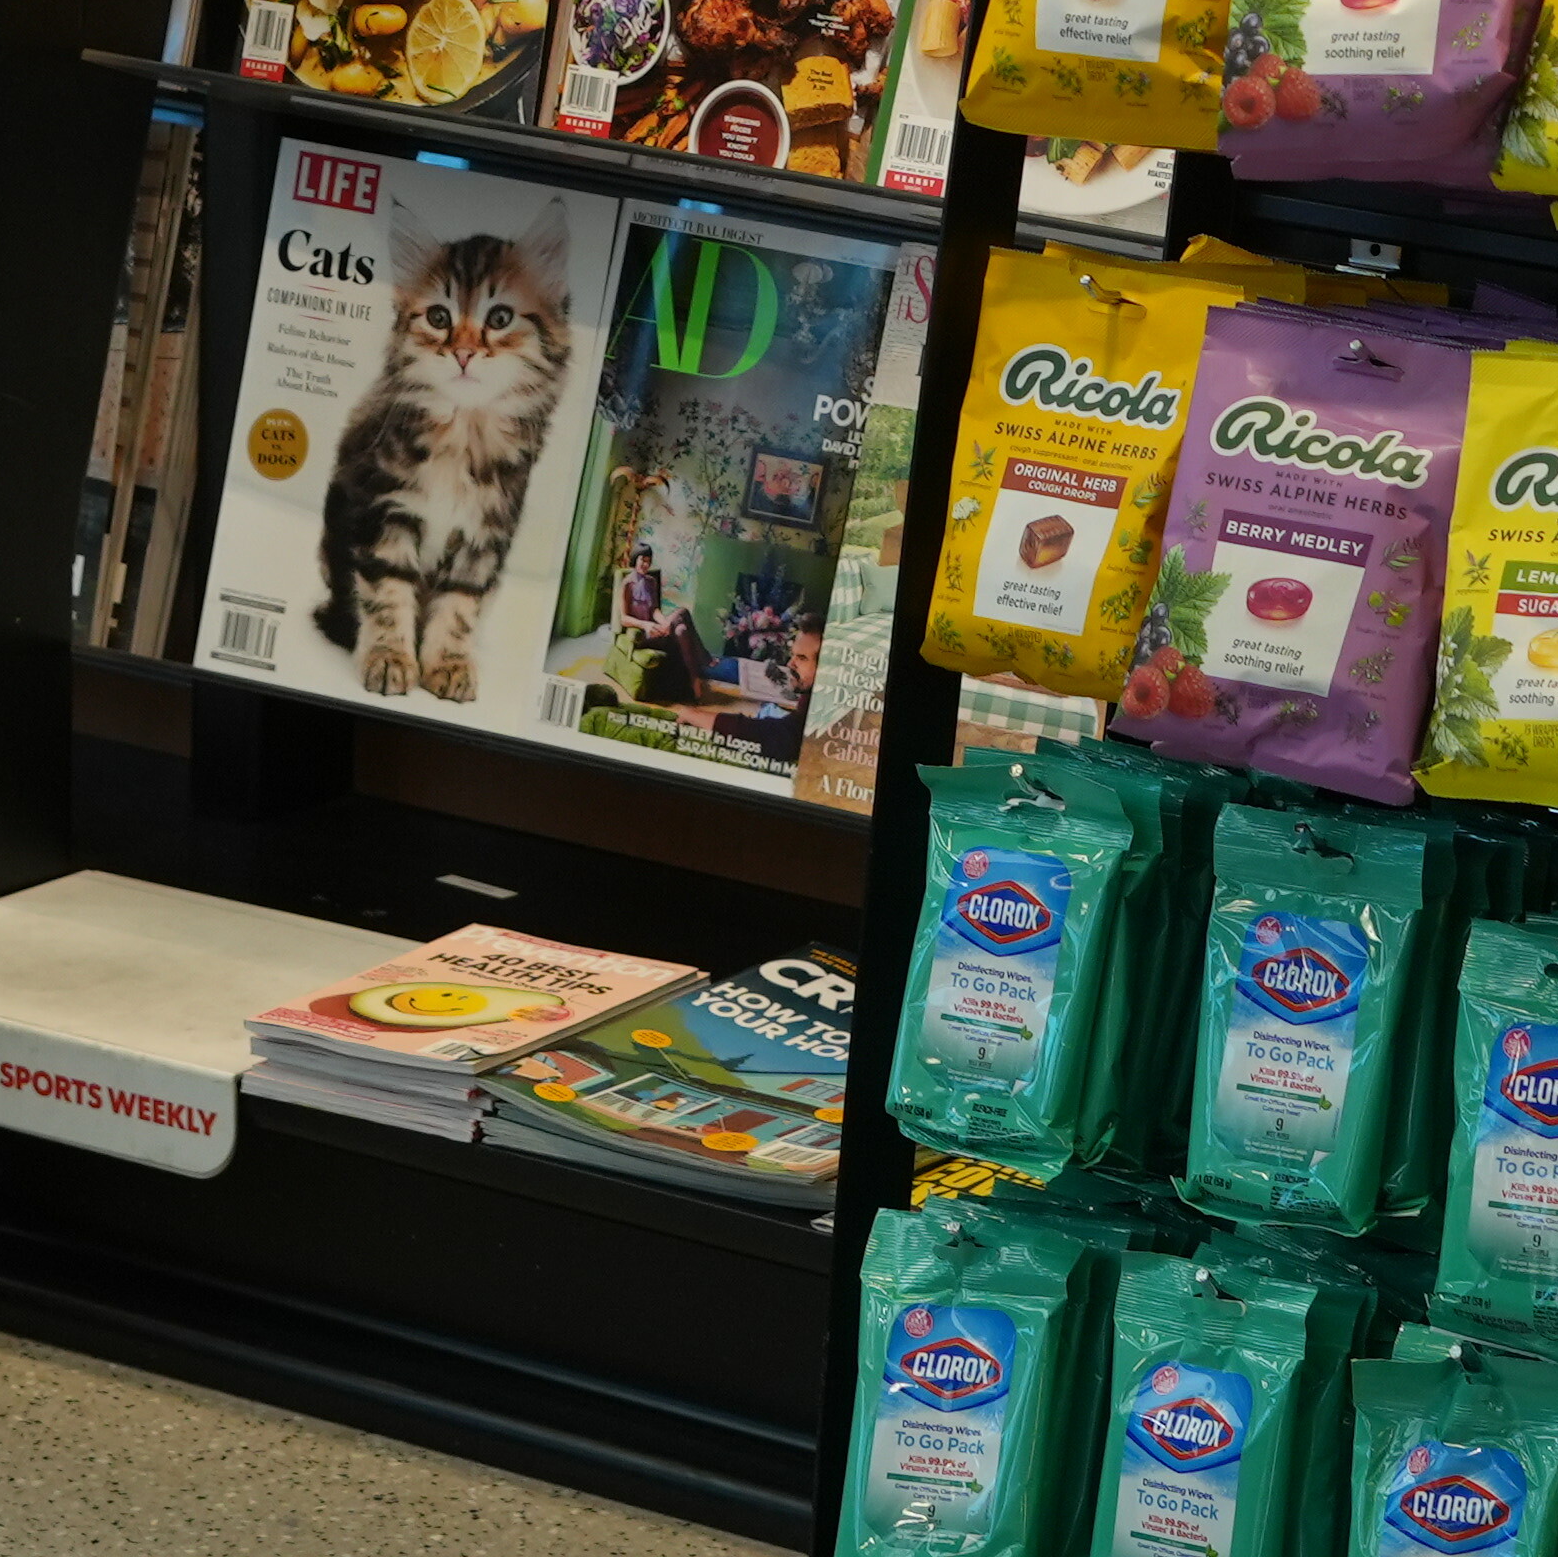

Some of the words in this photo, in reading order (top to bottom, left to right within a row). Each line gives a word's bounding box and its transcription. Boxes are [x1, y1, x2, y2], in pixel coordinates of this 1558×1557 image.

[295, 153, 380, 213] LIFE
[278, 230, 375, 284] Cats
[1002, 345, 1179, 428] Ricola
[967, 892, 1040, 934] CLOROX
[109, 1087, 217, 1138] WEEKLY
